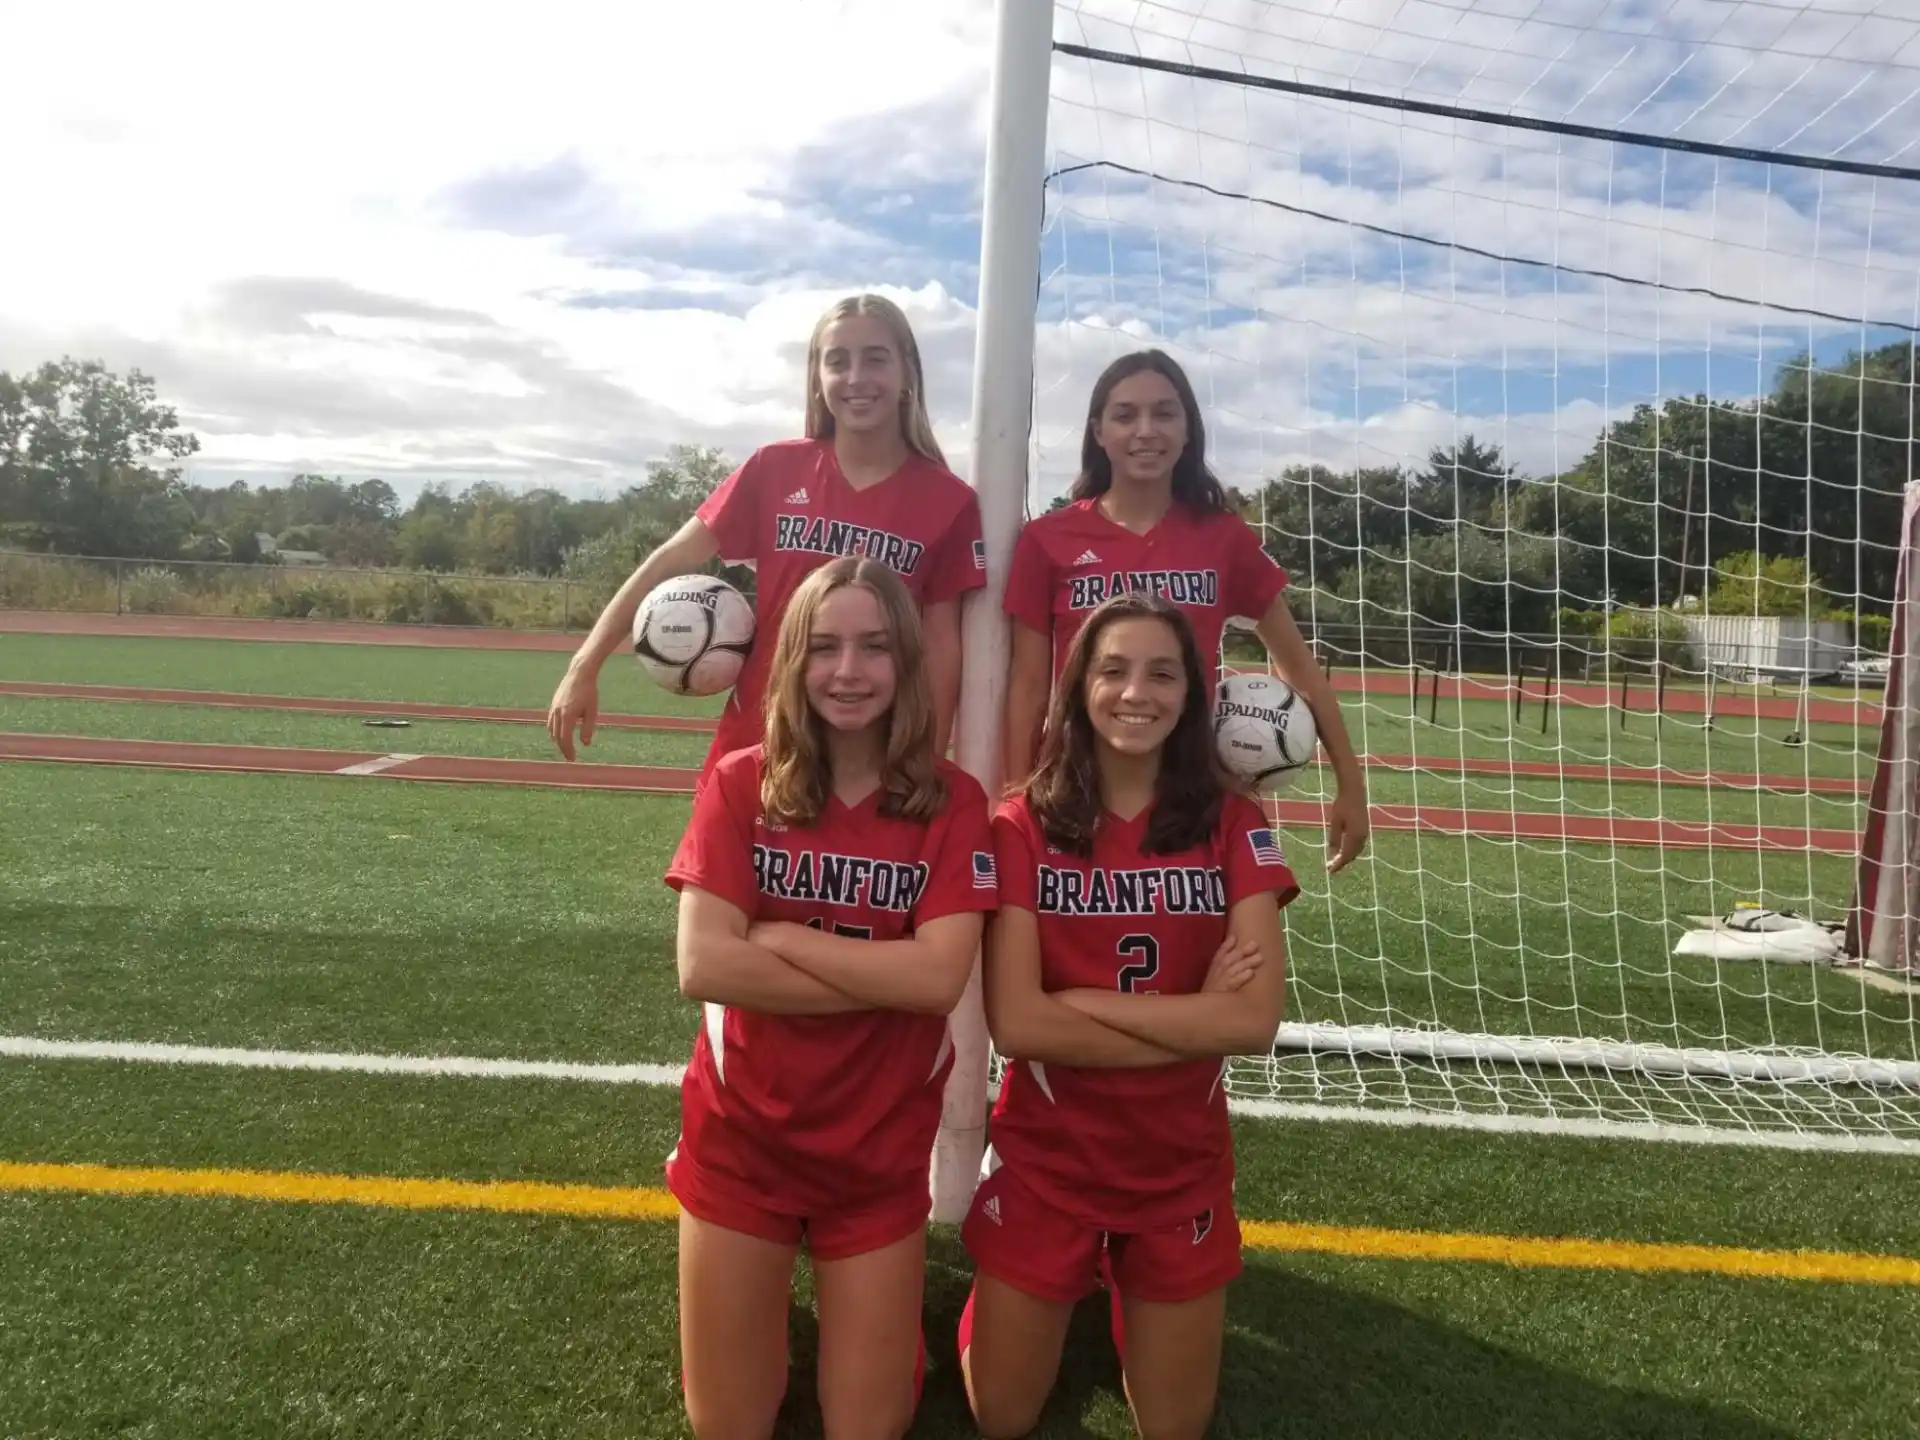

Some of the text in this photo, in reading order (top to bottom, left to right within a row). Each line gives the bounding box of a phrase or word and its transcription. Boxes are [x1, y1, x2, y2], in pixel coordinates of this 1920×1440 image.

[775, 513, 925, 577] BRANFORD
[1215, 701, 1289, 730] SPALDING
[1037, 864, 1226, 916] BRANFORD
[1116, 933, 1159, 996] 2
